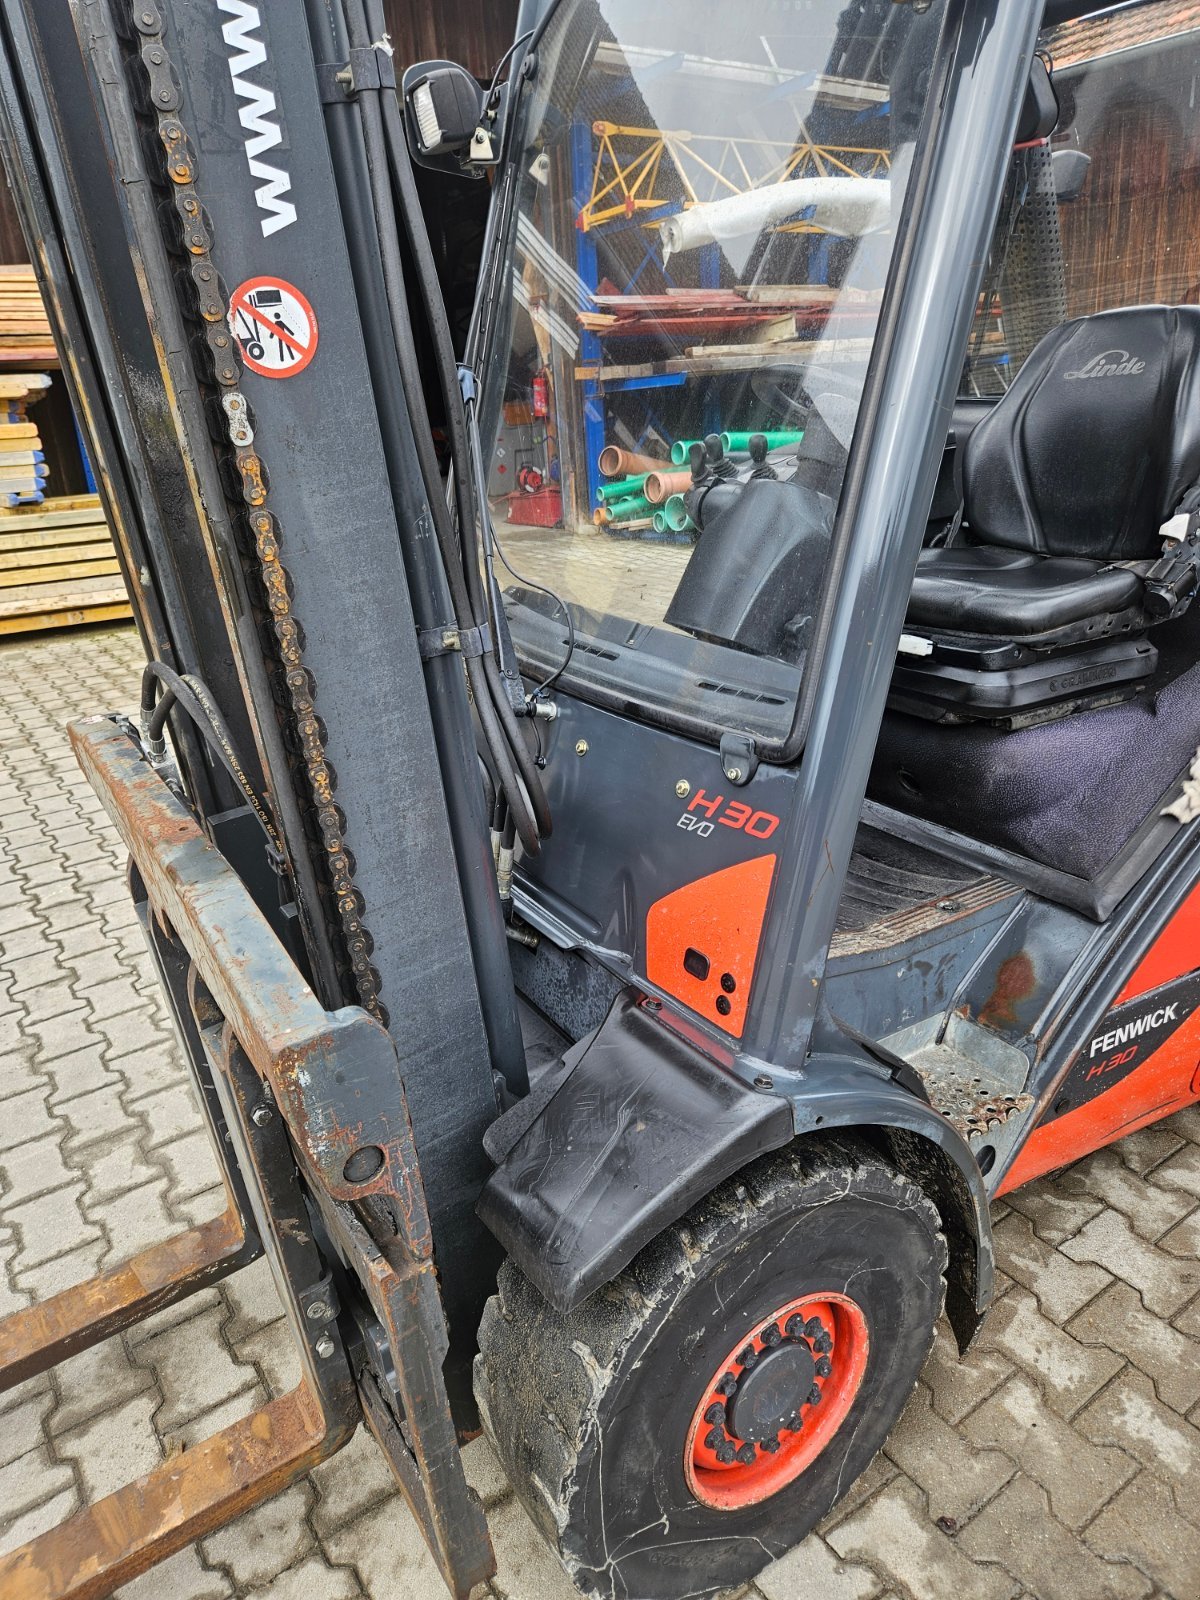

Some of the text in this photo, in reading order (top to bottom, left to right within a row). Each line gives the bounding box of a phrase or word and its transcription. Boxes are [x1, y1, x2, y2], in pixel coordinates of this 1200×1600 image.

[1063, 349, 1146, 380] Linde
[676, 813, 715, 838] EVO
[1089, 1001, 1180, 1059] FENWICK
